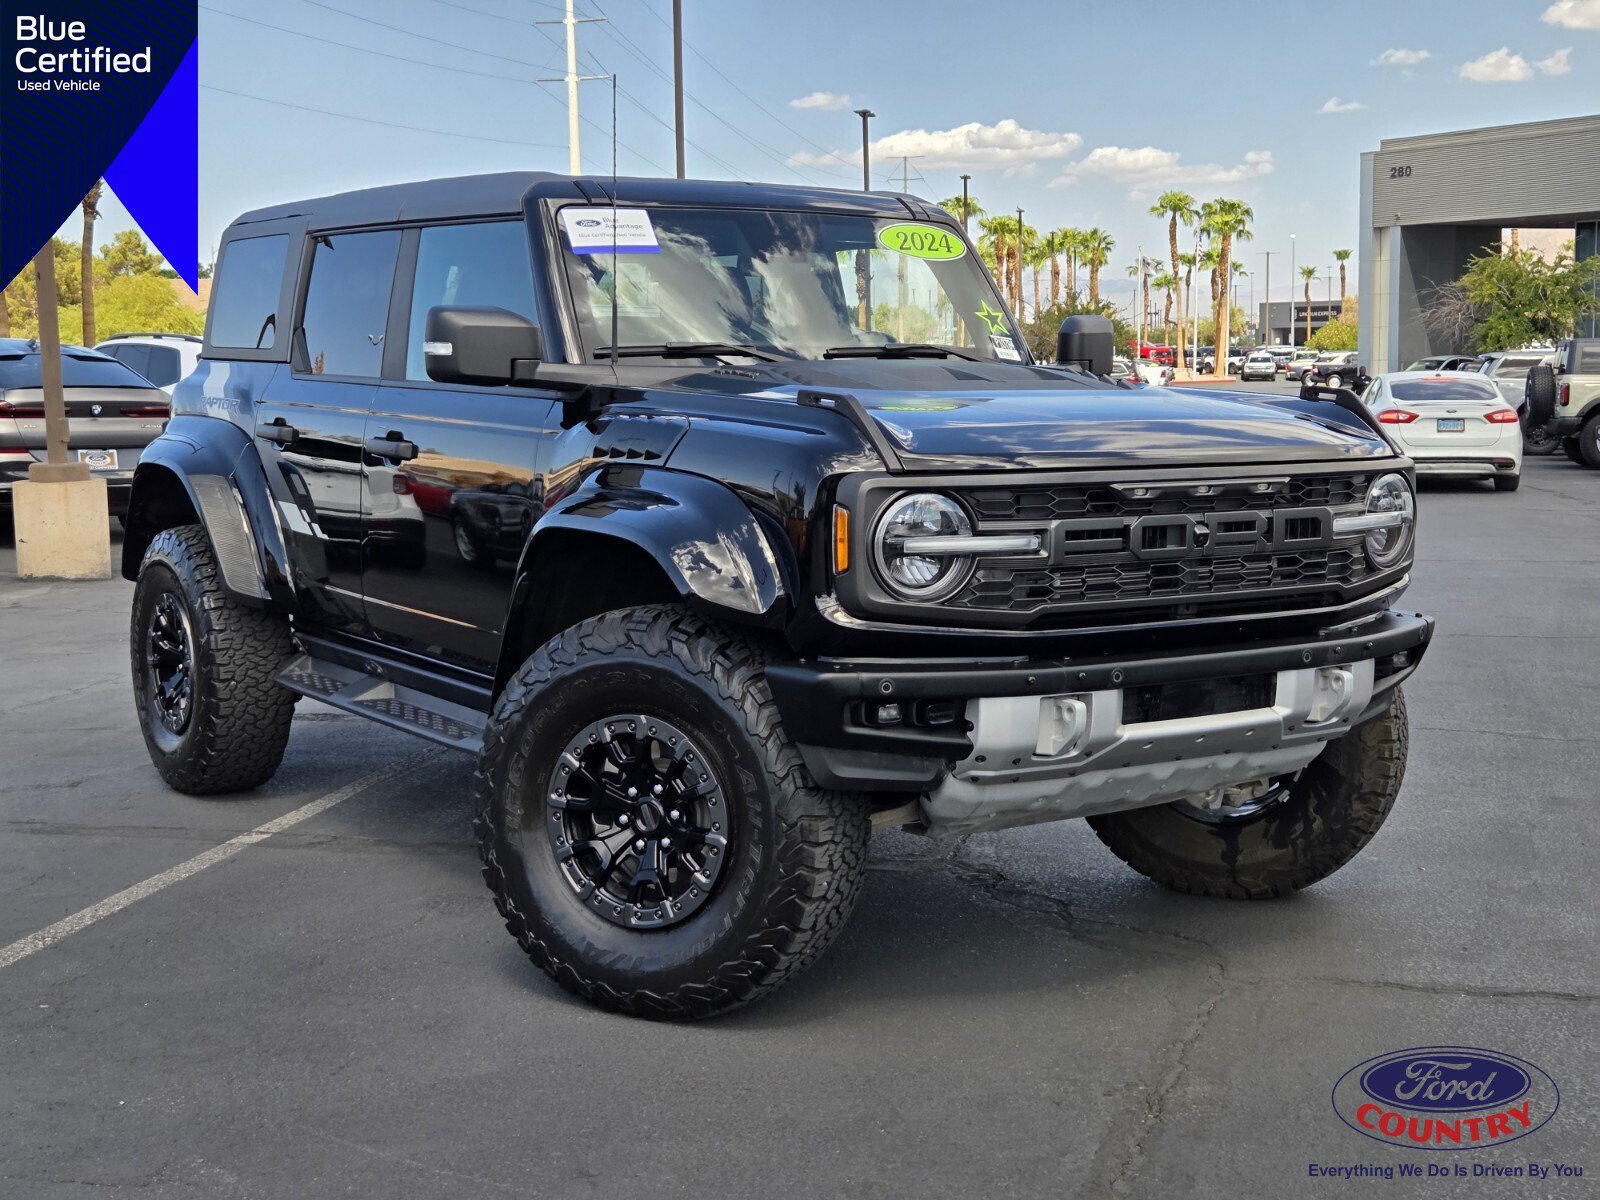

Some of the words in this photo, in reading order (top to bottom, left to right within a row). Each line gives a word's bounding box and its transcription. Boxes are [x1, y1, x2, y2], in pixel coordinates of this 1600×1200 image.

[1390, 166, 1412, 179] 280
[896, 231, 953, 254] 2024
[200, 396, 240, 411] RAPTOR
[1049, 506, 1333, 567] FORD
